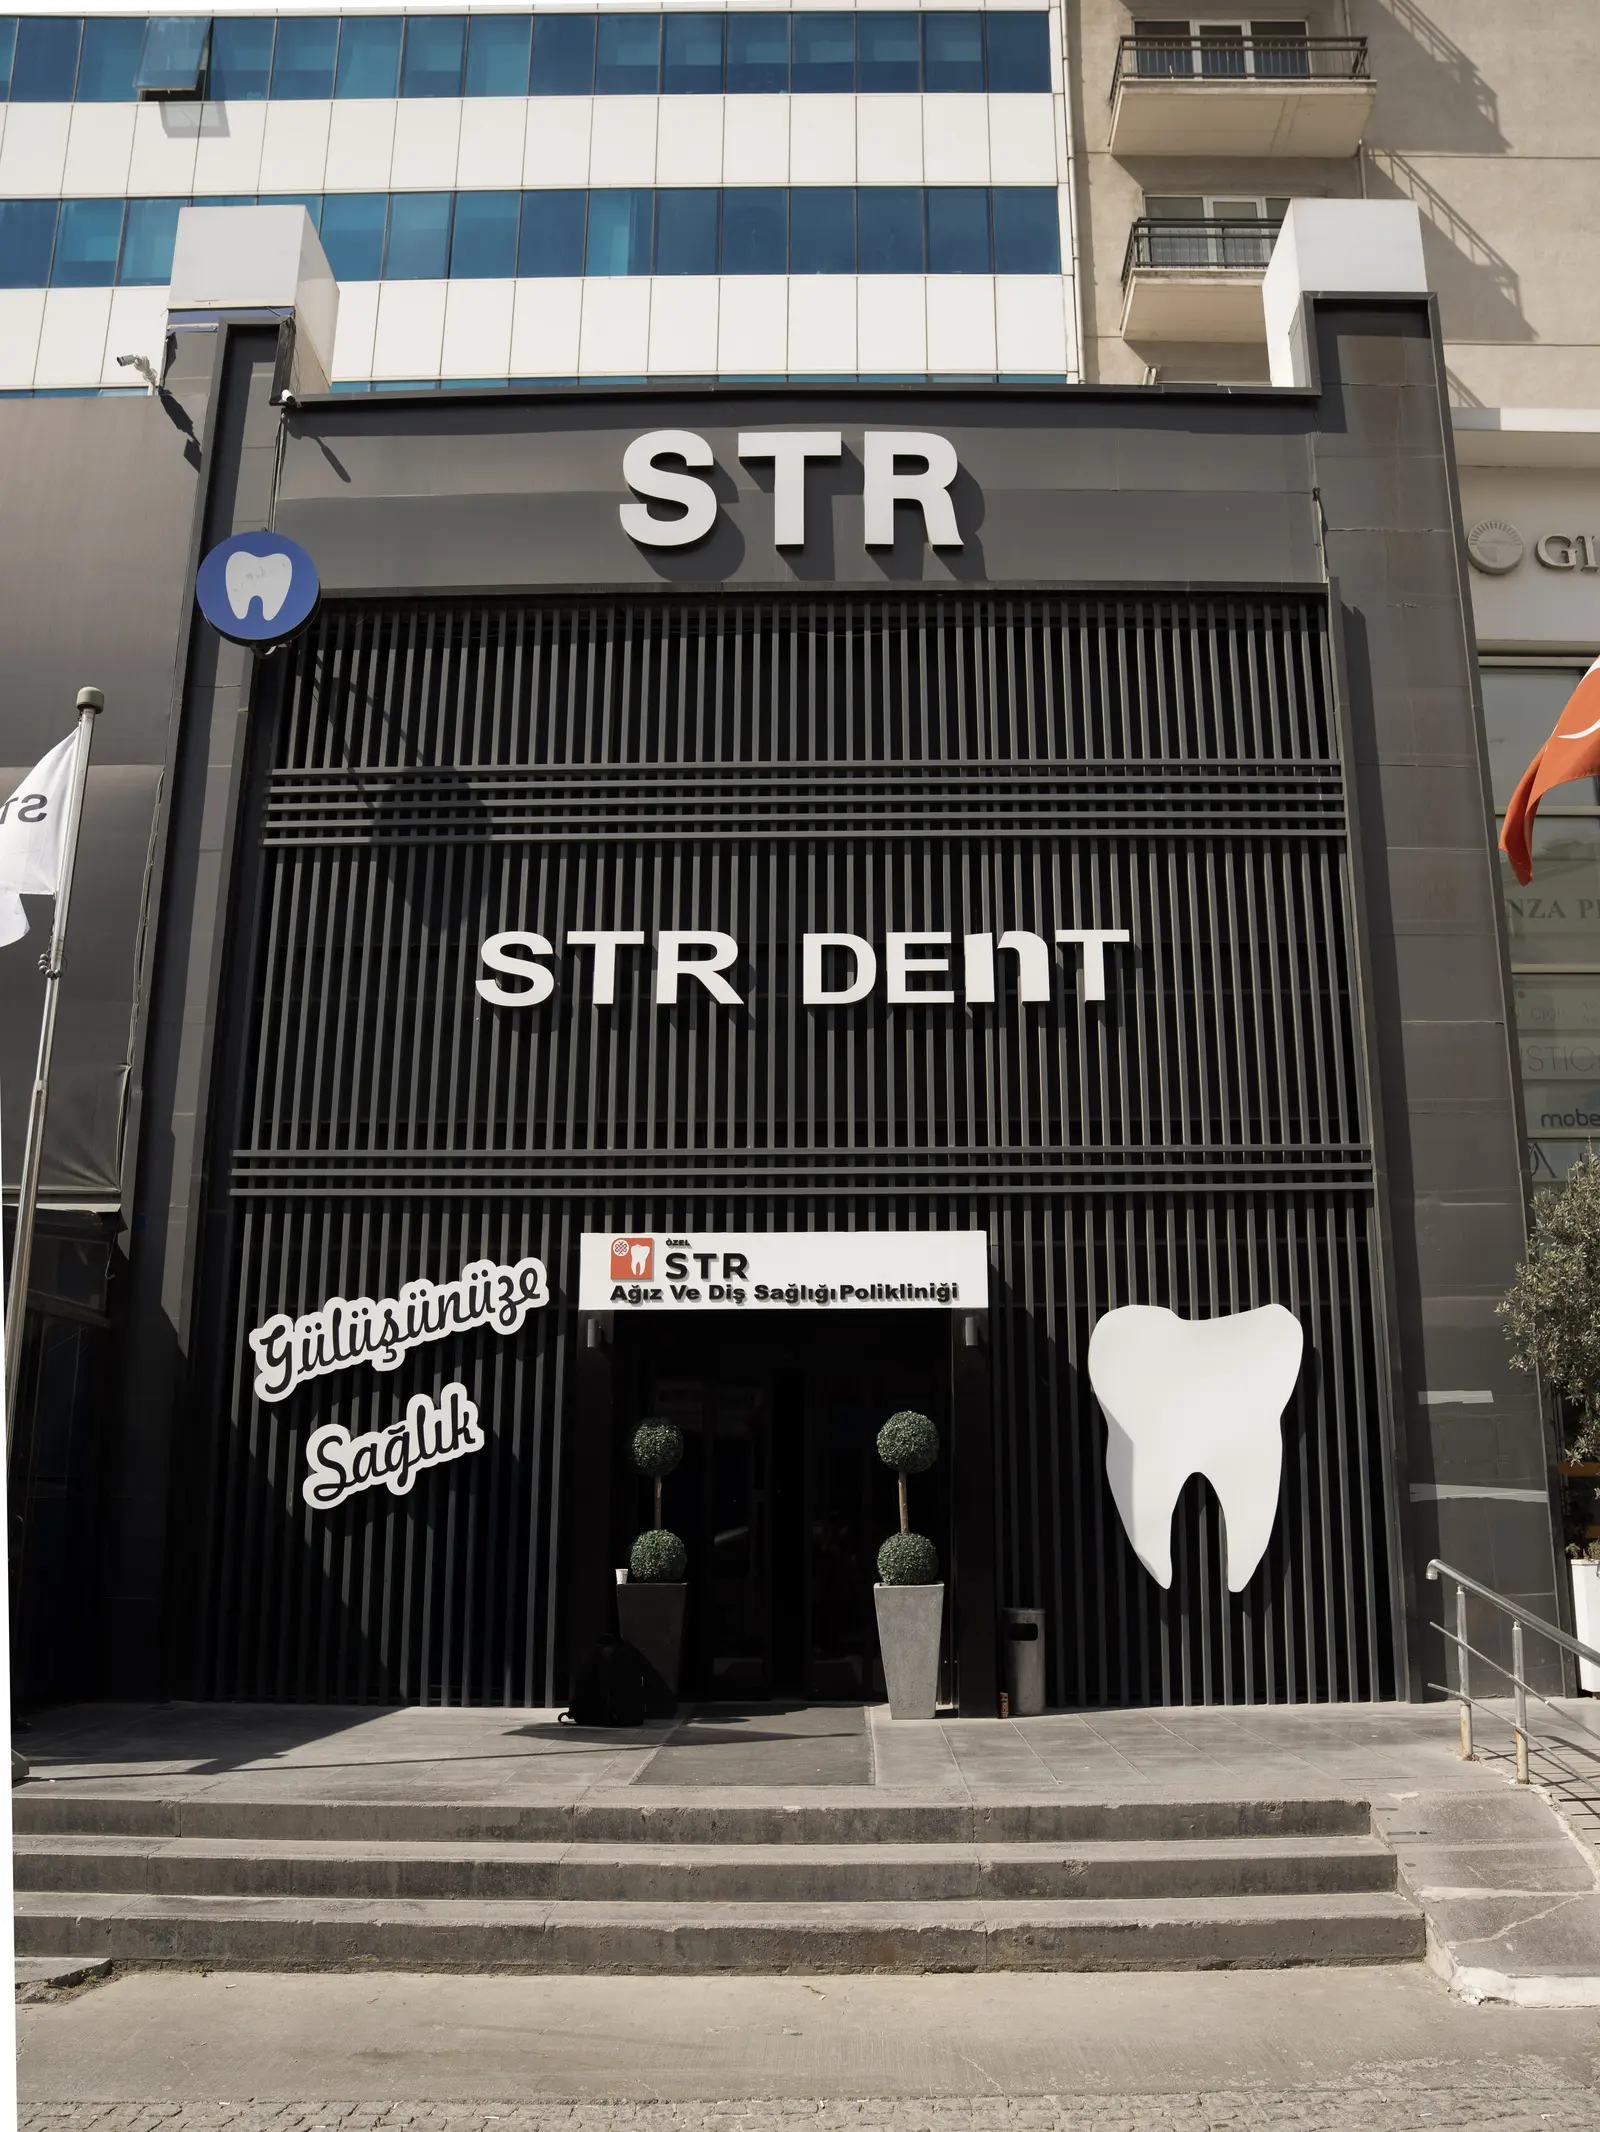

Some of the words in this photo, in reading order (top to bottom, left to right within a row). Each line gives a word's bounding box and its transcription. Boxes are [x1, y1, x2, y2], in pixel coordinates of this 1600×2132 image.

[619, 429, 965, 549] STR
[474, 930, 745, 1007] STR
[610, 1284, 663, 1305] Ağız
[669, 1284, 700, 1301] Ve
[708, 1283, 746, 1304] Diş
[754, 1283, 836, 1304] Sağlığı
[840, 1282, 958, 1304] Polikliniği
[665, 1252, 748, 1280] STR
[313, 1392, 476, 1502] Sağlık
